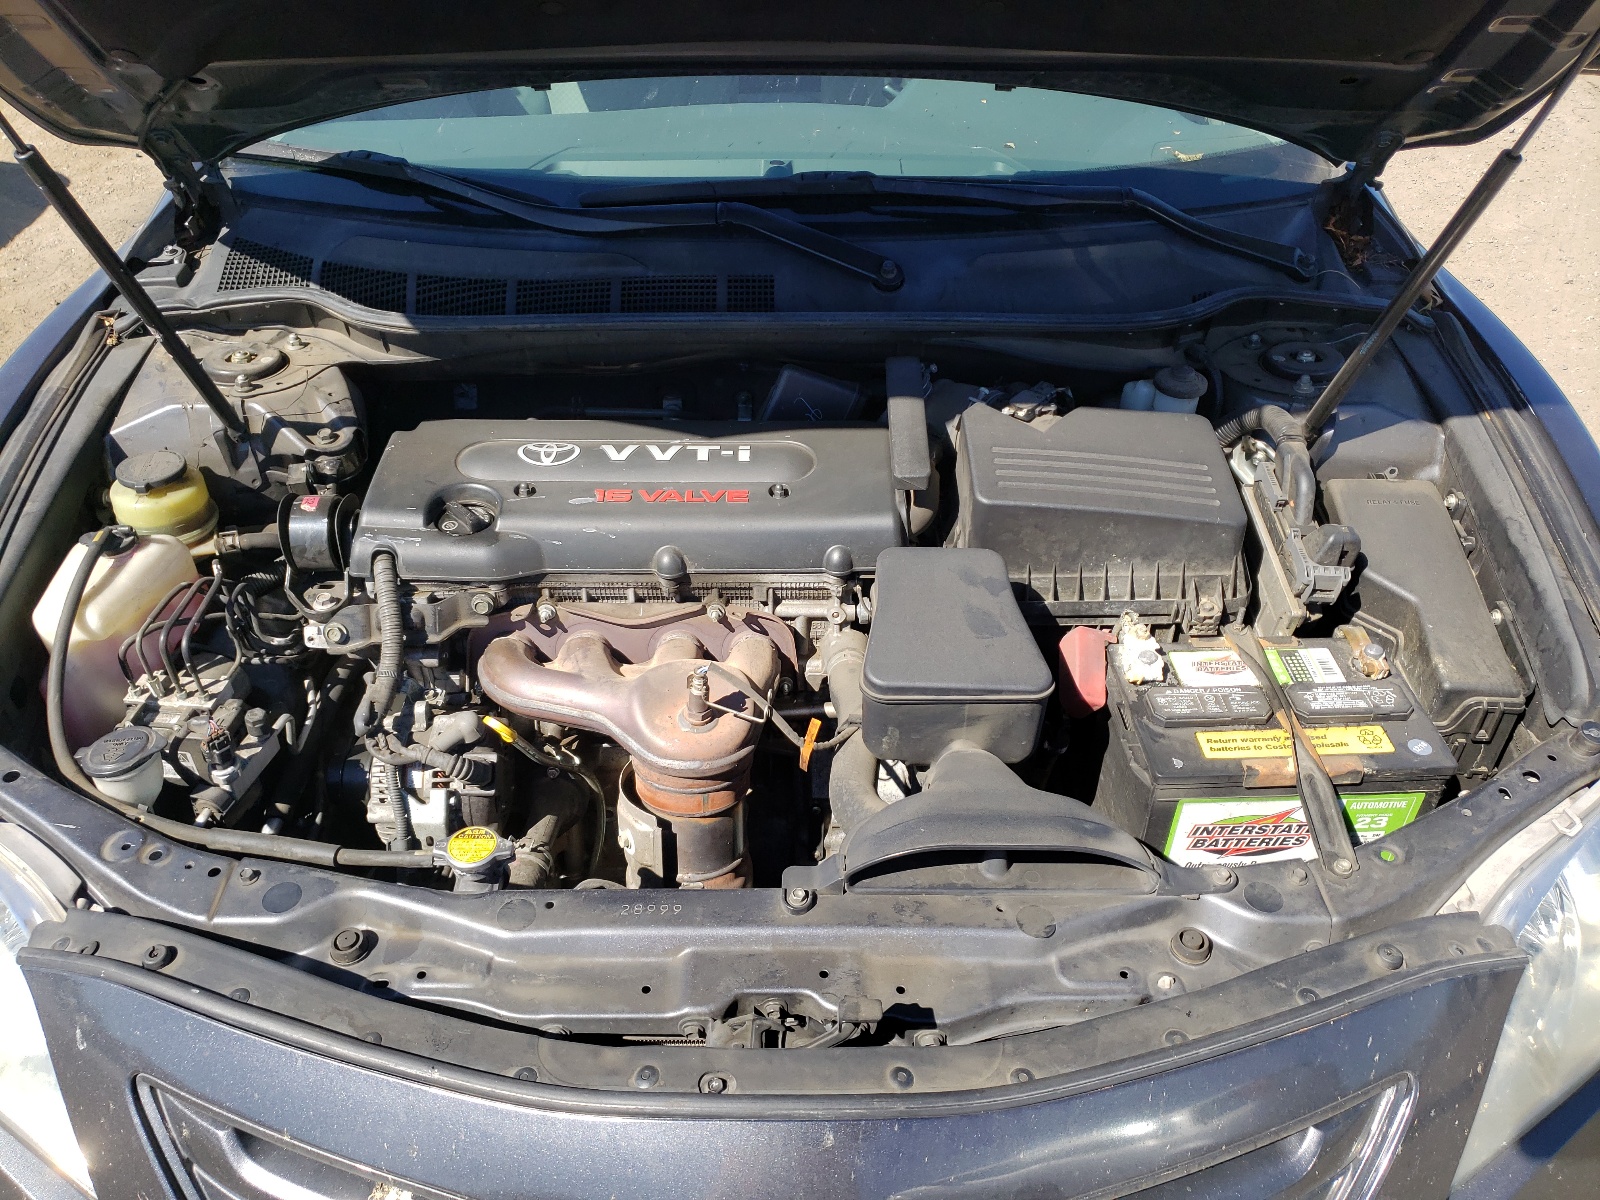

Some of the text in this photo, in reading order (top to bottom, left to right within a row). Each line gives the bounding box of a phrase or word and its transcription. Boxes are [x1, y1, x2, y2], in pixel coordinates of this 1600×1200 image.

[600, 444, 751, 462] VVT-i
[595, 489, 750, 503] 16 VALVE
[1240, 736, 1281, 744] warranty
[1350, 801, 1409, 810] AUTOMOTIVE
[1354, 817, 1389, 829] 23
[1191, 836, 1305, 849] BATTERIES
[620, 904, 682, 915] 28999
